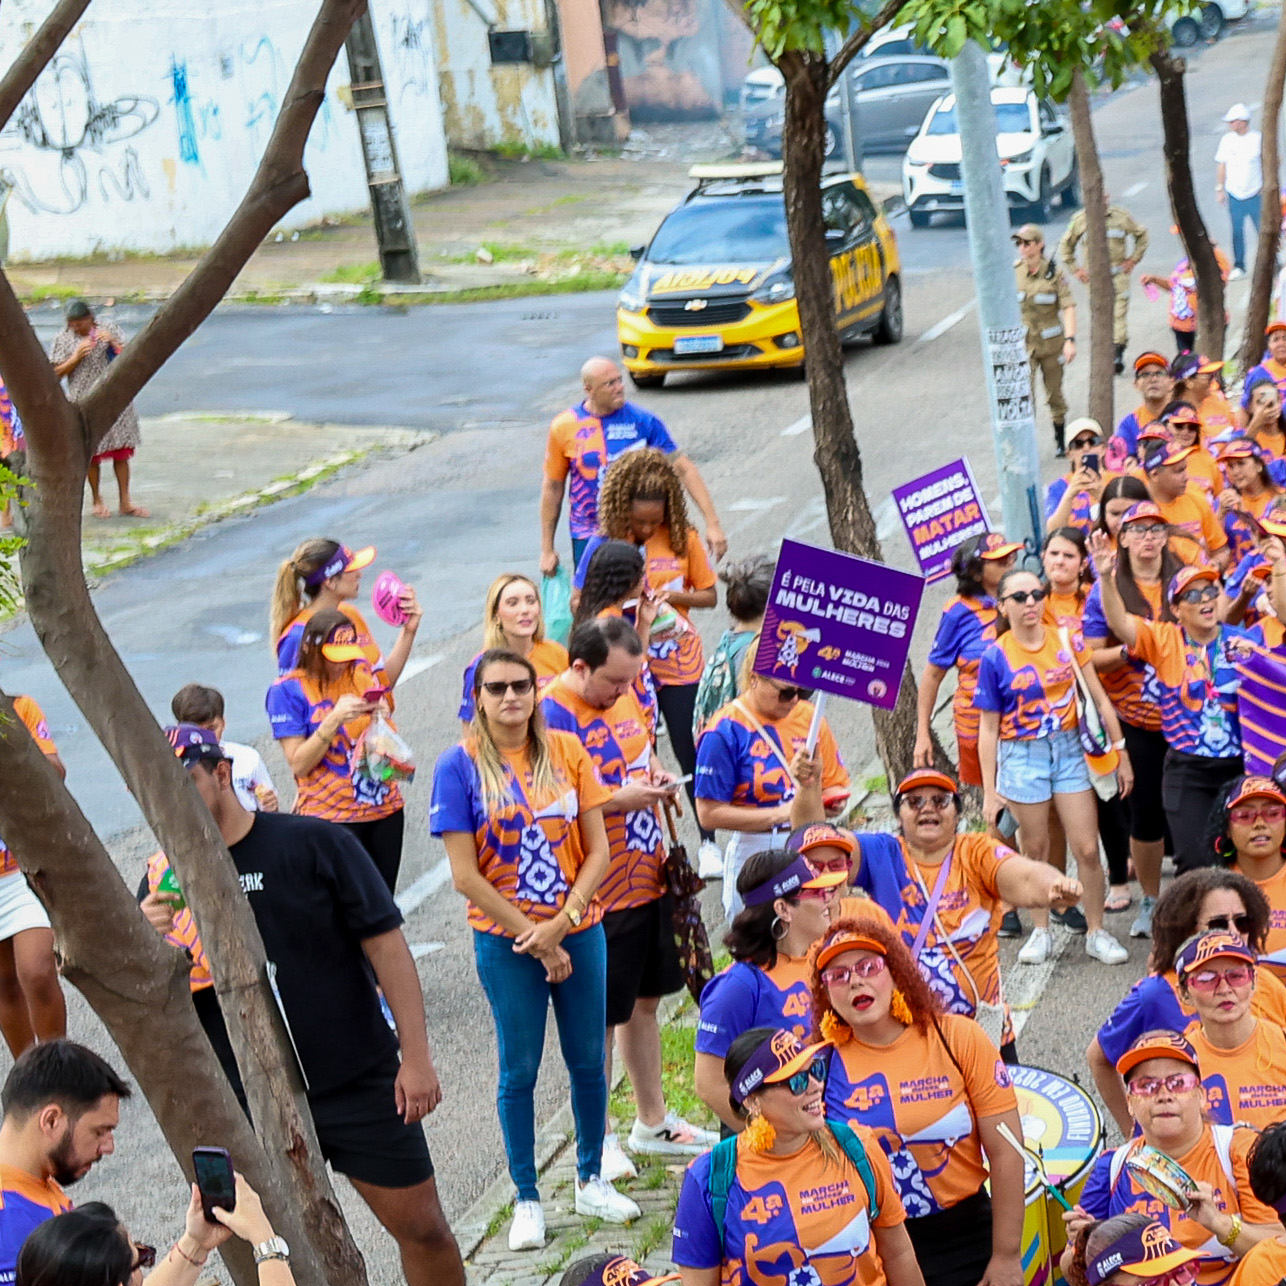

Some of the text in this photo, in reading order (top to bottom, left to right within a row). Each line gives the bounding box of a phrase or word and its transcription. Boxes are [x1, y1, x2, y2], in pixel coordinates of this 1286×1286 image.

[899, 472, 969, 513] HOMENS,
[906, 486, 975, 528] PAREM DE
[913, 501, 980, 546] MATAR
[775, 589, 907, 639] MULHERES
[781, 569, 911, 621] É PELA VIDA DAS
[900, 1075, 950, 1089] MARCHA
[900, 1089, 954, 1104] MULHER
[1041, 1081, 1071, 1101] EM
[1058, 1096, 1093, 1142] FUNDADO
[800, 1194, 855, 1216] MULHER
[1100, 1253, 1122, 1272] ALECE
